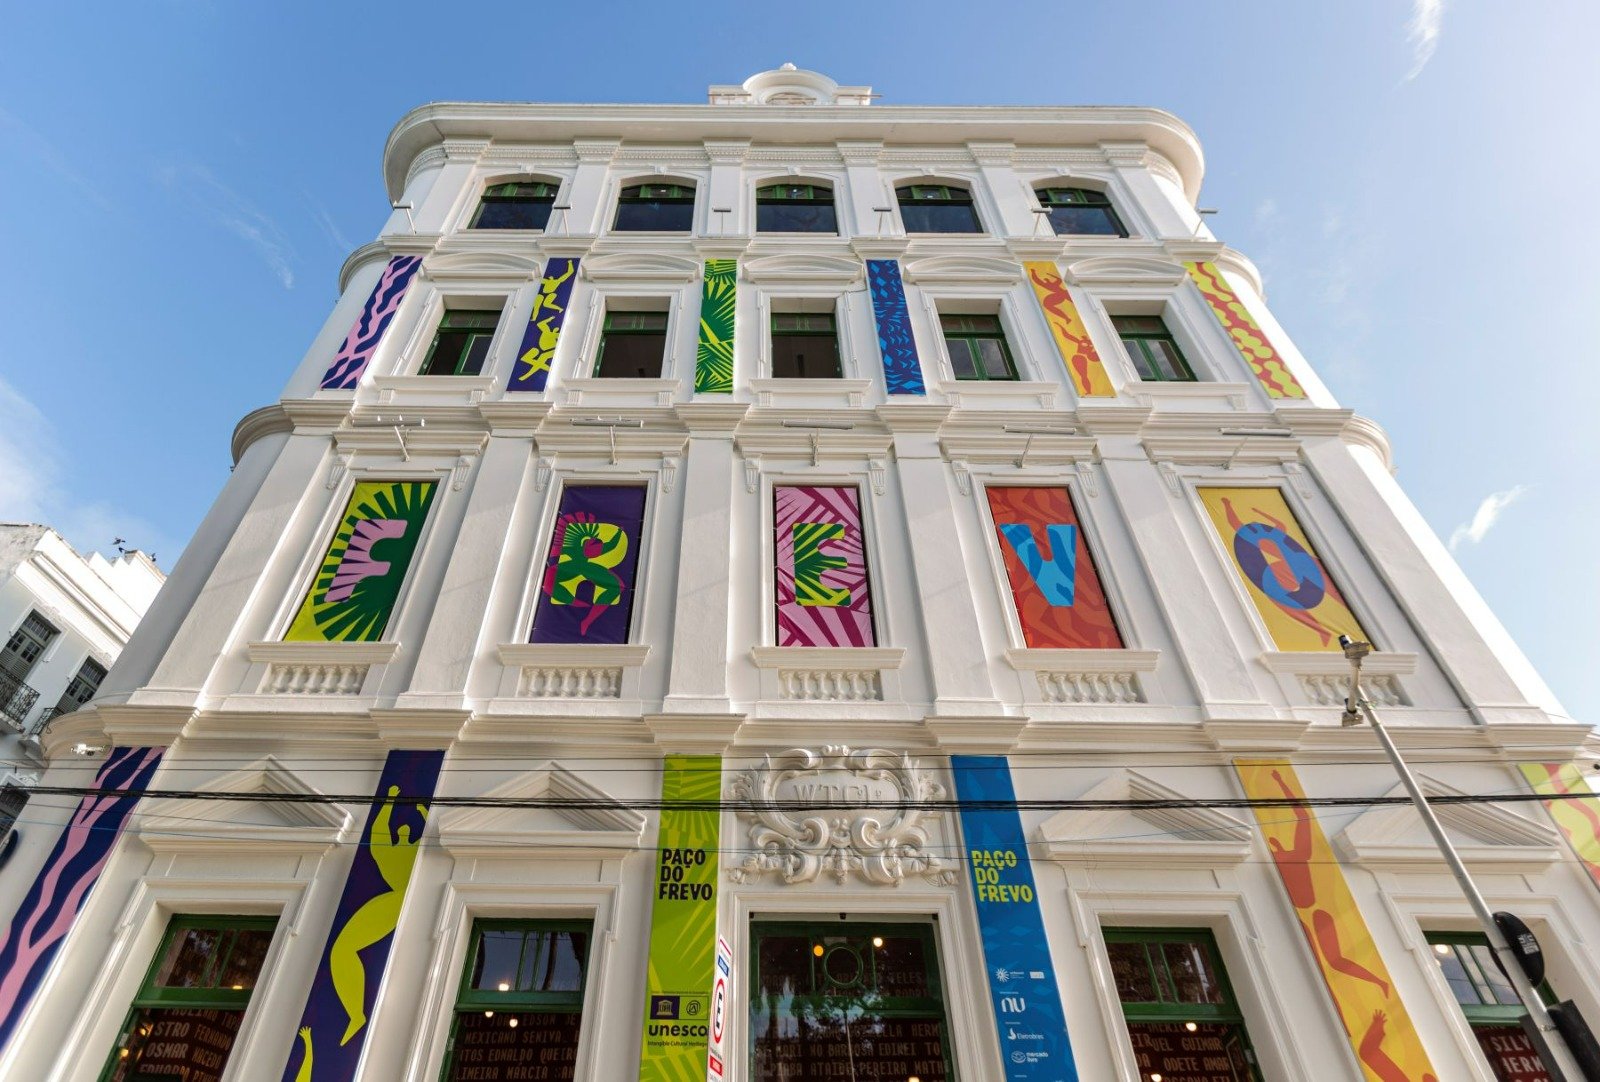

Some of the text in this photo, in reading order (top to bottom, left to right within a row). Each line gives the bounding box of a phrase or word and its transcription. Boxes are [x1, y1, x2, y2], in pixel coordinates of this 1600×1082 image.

[661, 848, 706, 868] PAÇO
[971, 850, 1017, 870] PAÇO
[660, 865, 684, 882] DO
[974, 867, 1000, 885] DO
[659, 883, 713, 901] FREVO
[977, 884, 1034, 903] FREVO
[648, 1024, 708, 1037] unesco
[145, 1042, 189, 1059] OSMAR
